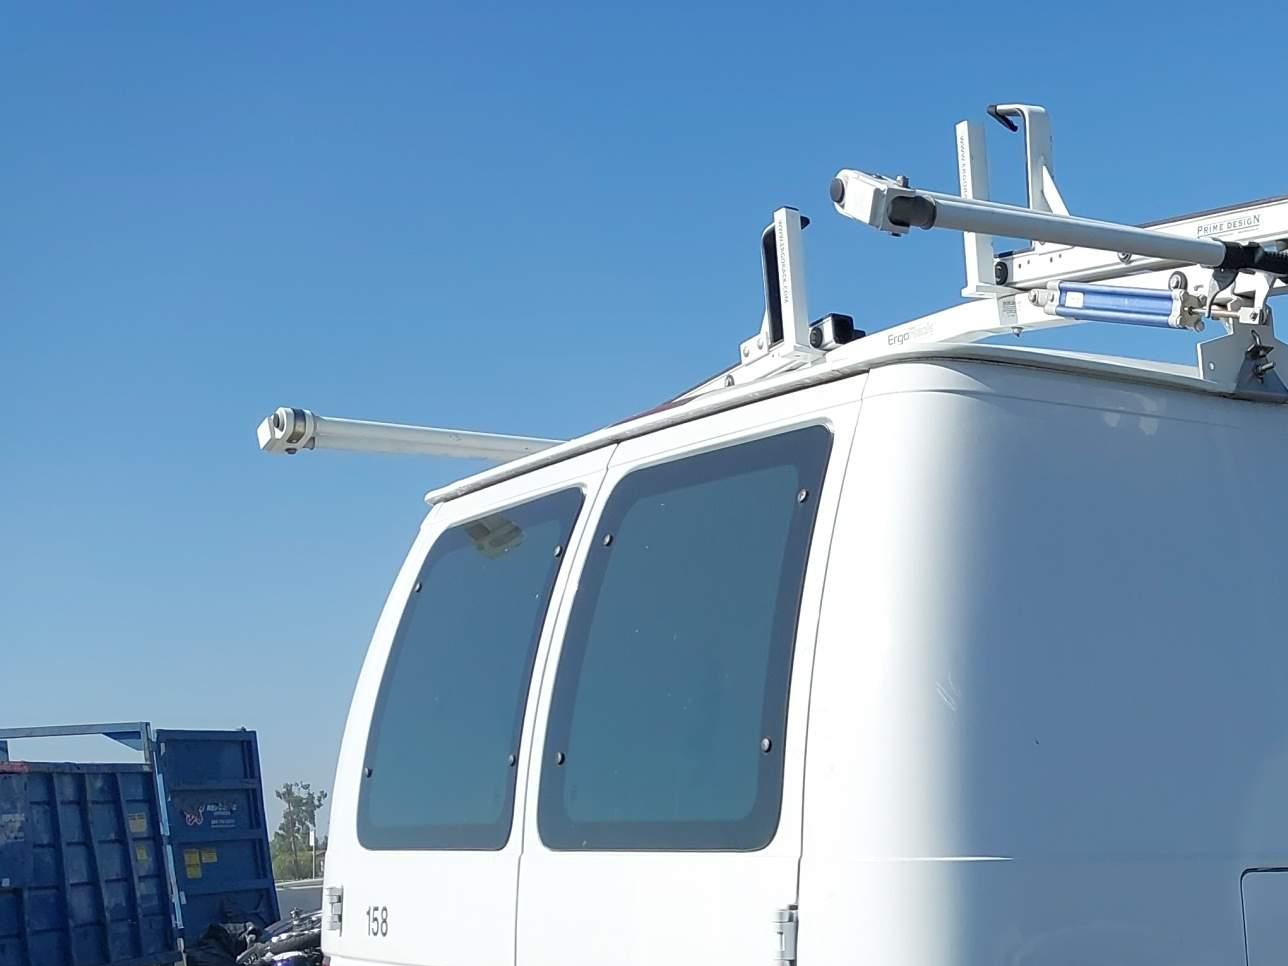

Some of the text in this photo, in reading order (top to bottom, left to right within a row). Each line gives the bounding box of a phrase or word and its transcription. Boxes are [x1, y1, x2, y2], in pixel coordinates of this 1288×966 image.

[1197, 223, 1224, 235] PRIME
[1227, 214, 1261, 229] DESIGN
[366, 906, 388, 937] 158
